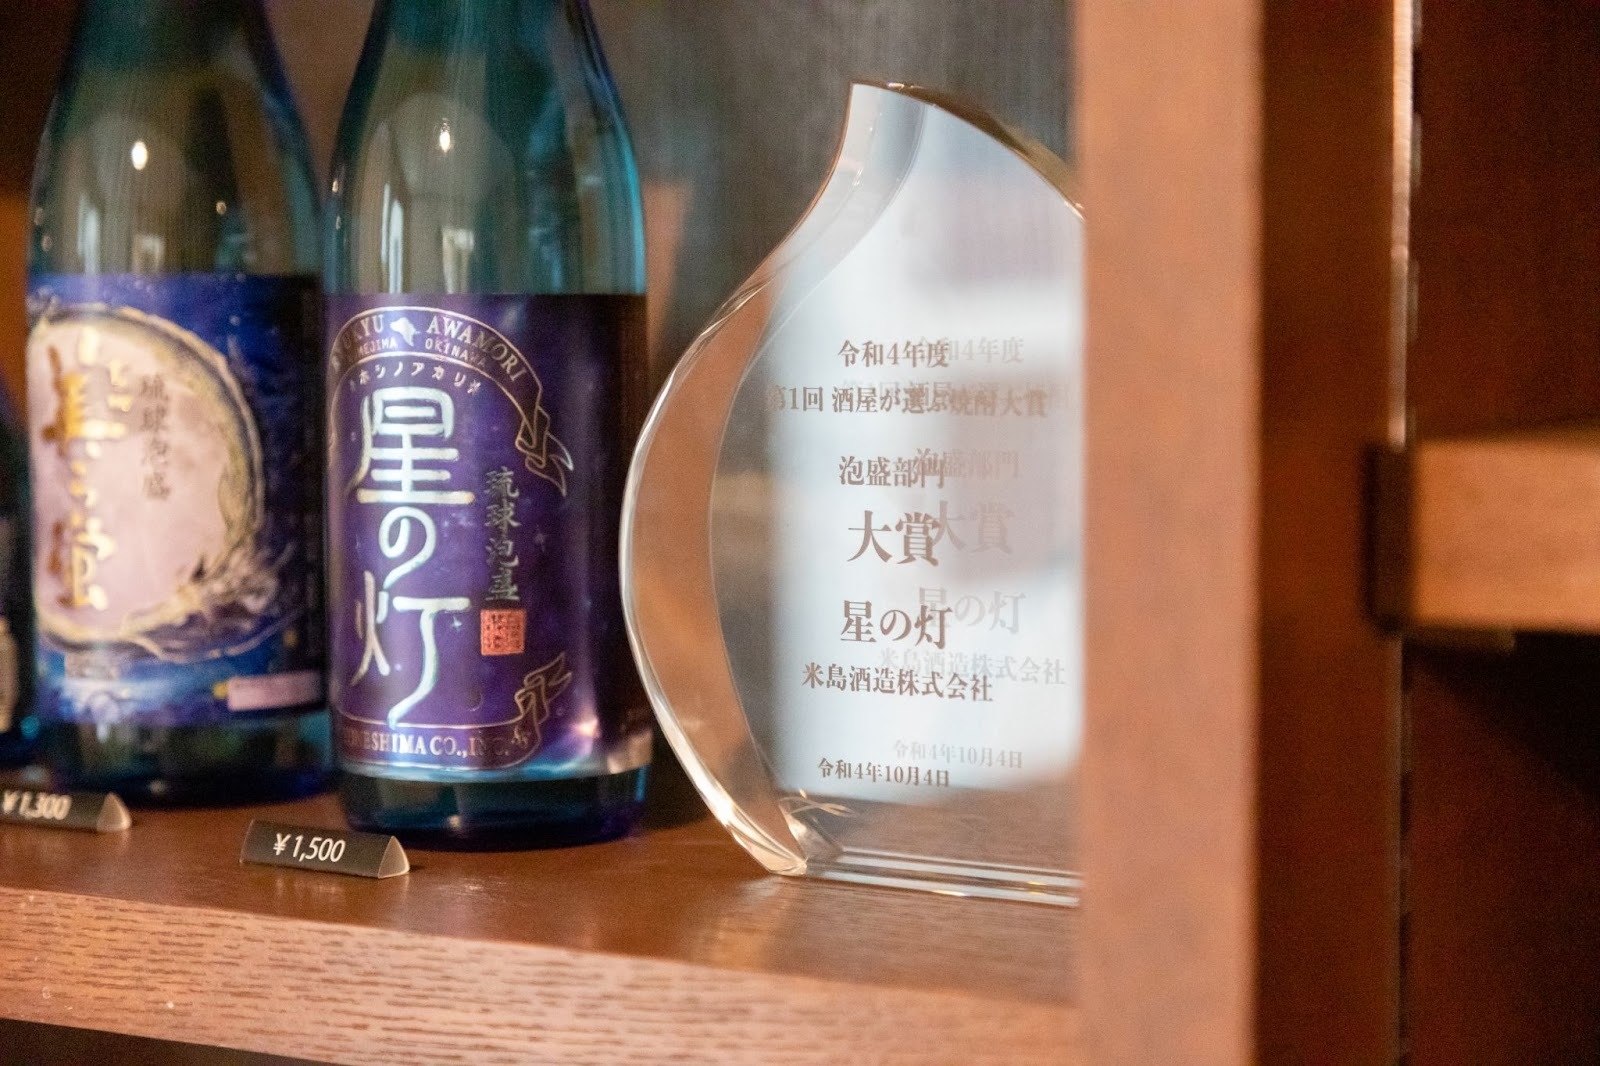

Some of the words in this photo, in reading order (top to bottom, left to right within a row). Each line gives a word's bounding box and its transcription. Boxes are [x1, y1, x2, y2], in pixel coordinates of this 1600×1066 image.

[426, 315, 527, 382] AWAMORI
[838, 338, 951, 368] 令和4年度
[838, 455, 946, 488] 泡盛部門
[345, 386, 476, 729] 星の灯
[847, 509, 939, 567] 大賞
[840, 600, 953, 650] 星の灯
[801, 661, 993, 702] 米島酒造株式会社
[818, 756, 950, 787] 令和4年10月4日
[272, 832, 347, 863] ¥1,500
